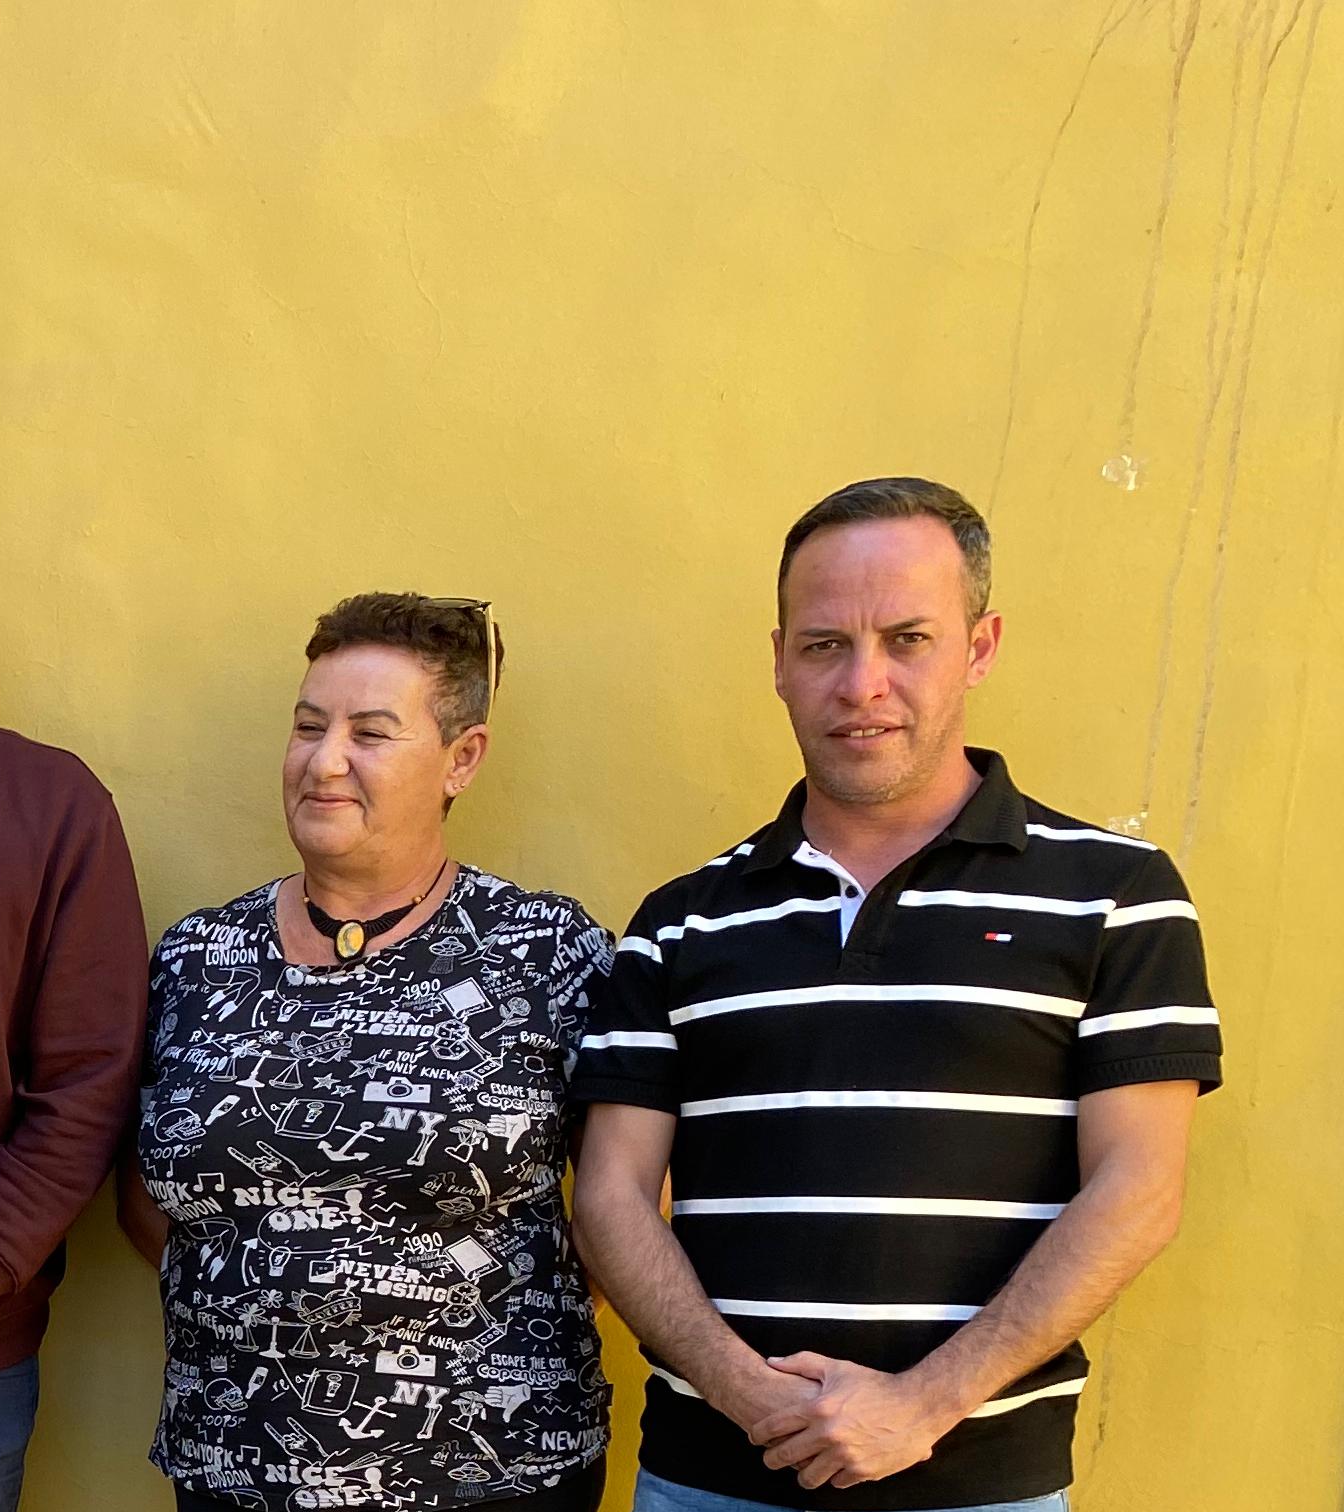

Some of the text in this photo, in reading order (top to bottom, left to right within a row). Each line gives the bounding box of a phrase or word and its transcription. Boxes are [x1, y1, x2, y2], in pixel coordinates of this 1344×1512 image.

[206, 947, 258, 966] LONDON
[402, 979, 440, 999] 1990
[337, 1009, 411, 1024] NEVER
[354, 1022, 434, 1037] LOSING
[378, 1049, 418, 1063] IF YOU
[386, 1061, 459, 1081] ONLY KNEW
[377, 1106, 447, 1135] NY
[424, 1182, 439, 1193] OH
[404, 1232, 443, 1254] 1990
[336, 1260, 420, 1284] NEVER
[362, 1278, 447, 1302] LOSING
[524, 1289, 555, 1310] BREAK
[214, 1324, 244, 1341] 1990
[389, 1314, 429, 1331] IF YOU
[396, 1328, 464, 1351] ONLY KNEW
[490, 1354, 525, 1368] ESCAPE
[389, 1379, 451, 1409] NY
[433, 1451, 447, 1462] OH
[205, 1468, 254, 1489] LONDON
